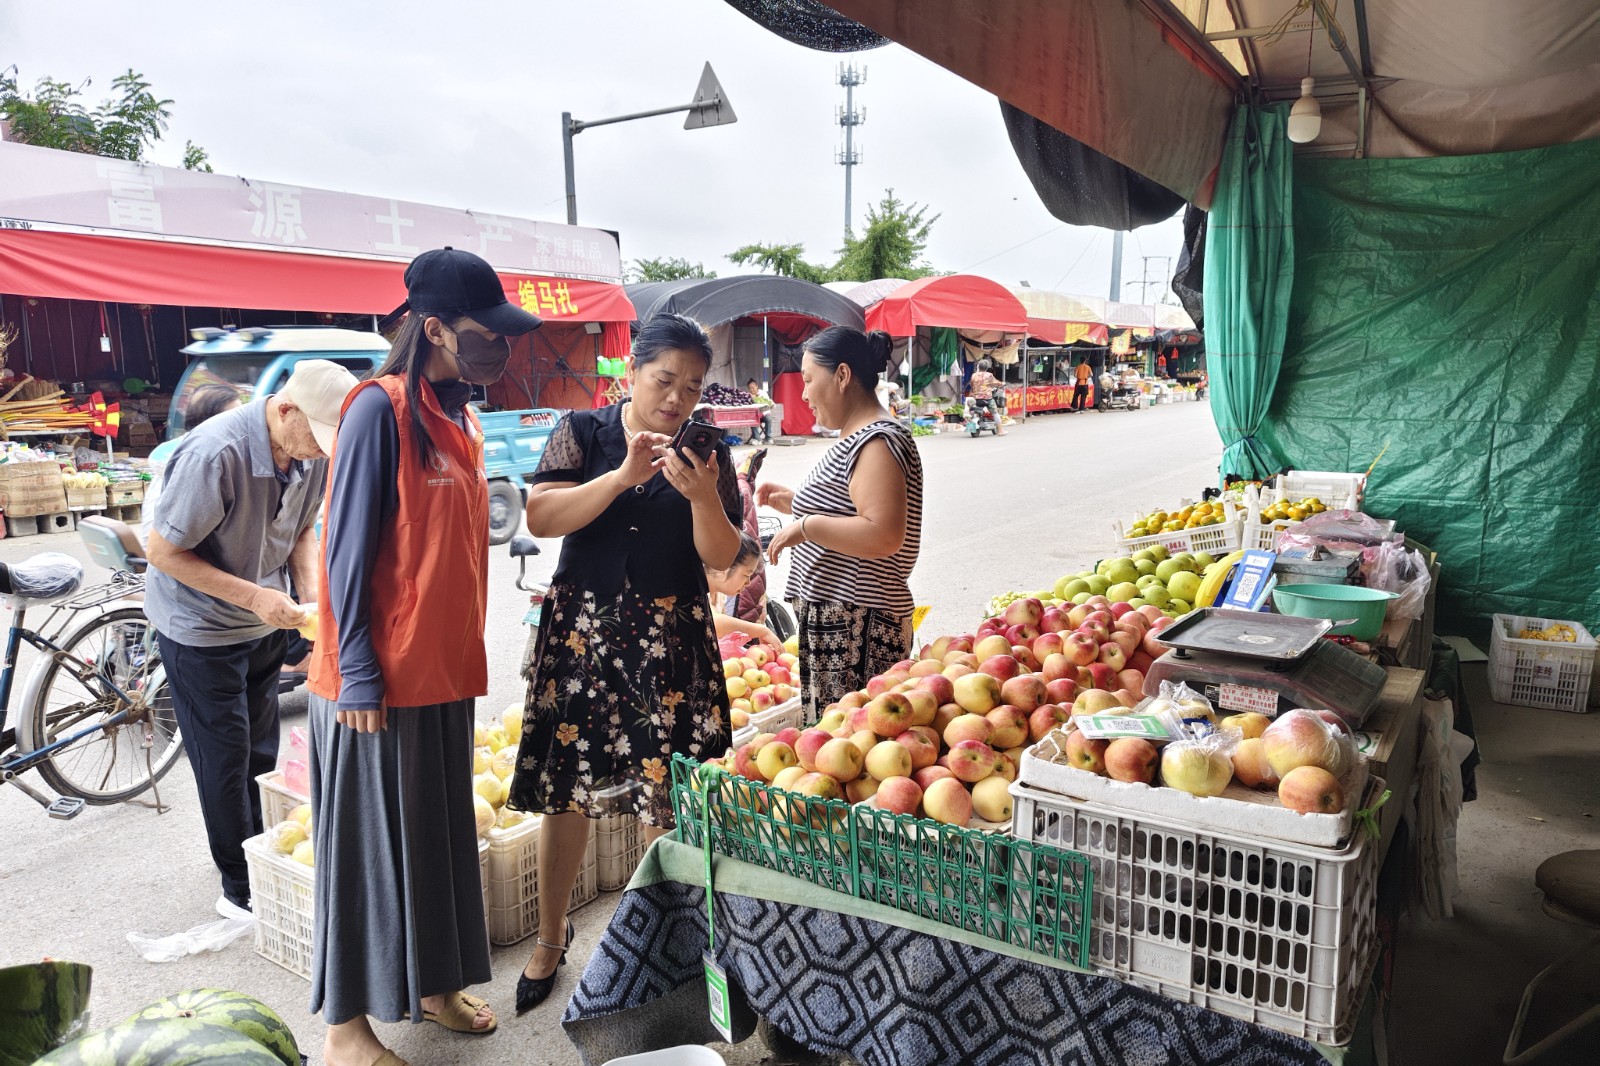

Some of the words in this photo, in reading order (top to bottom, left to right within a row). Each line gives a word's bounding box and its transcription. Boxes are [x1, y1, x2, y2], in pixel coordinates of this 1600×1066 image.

[535, 235, 602, 260] 家庭用品
[517, 280, 579, 315] 编马扎
